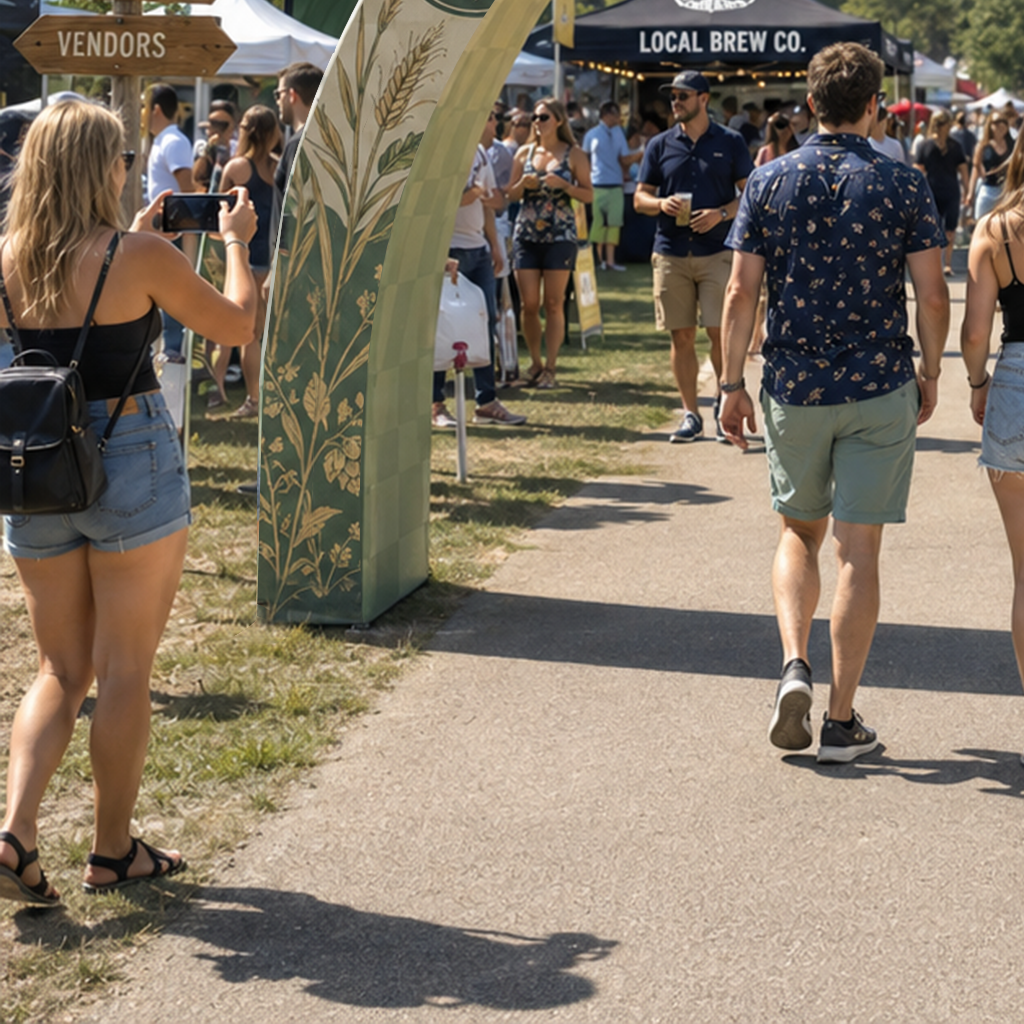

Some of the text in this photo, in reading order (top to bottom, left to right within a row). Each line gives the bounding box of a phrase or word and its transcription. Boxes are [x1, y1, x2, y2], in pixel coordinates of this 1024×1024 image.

[57, 31, 167, 58] VENDORS
[639, 30, 807, 53] LOCAL BREW CO.
